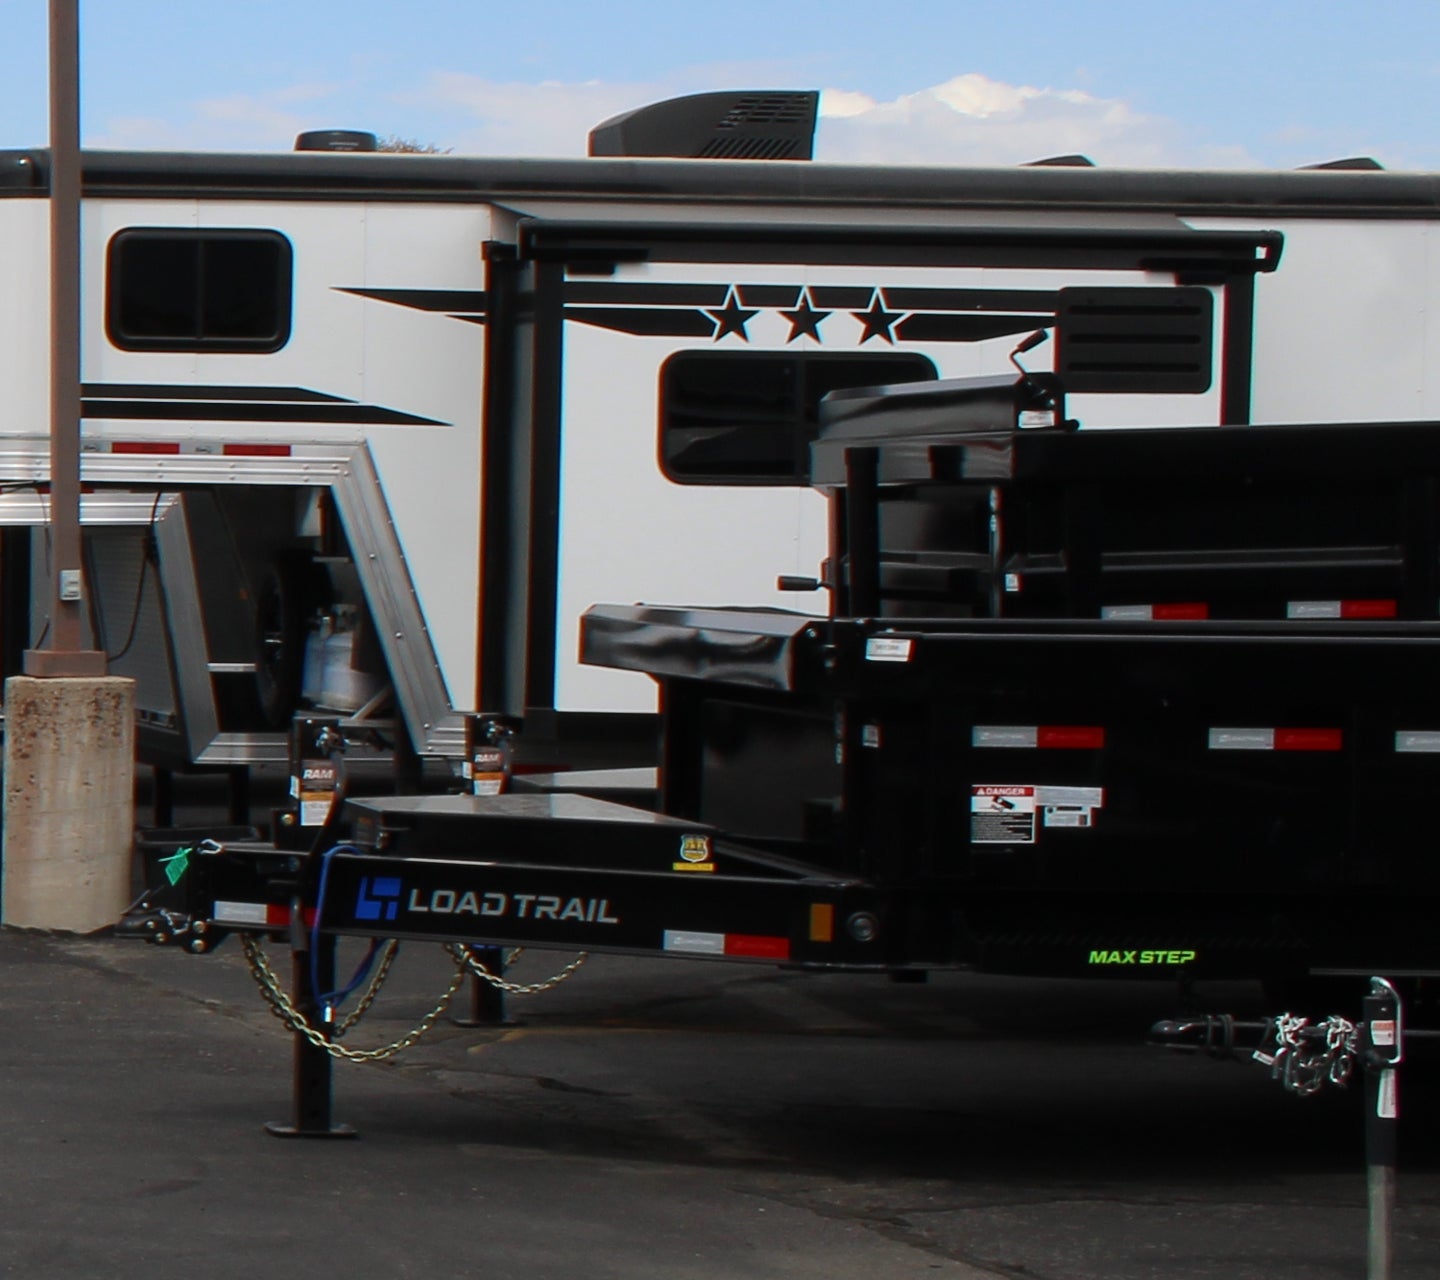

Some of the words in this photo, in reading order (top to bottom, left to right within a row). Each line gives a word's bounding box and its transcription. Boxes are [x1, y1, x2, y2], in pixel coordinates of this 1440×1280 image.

[303, 768, 335, 779] RAM
[985, 787, 1025, 796] DANGER
[407, 888, 507, 916] LOAD
[513, 894, 619, 924] TRAIL
[1088, 950, 1137, 964] MAX
[1139, 950, 1196, 964] STEP
